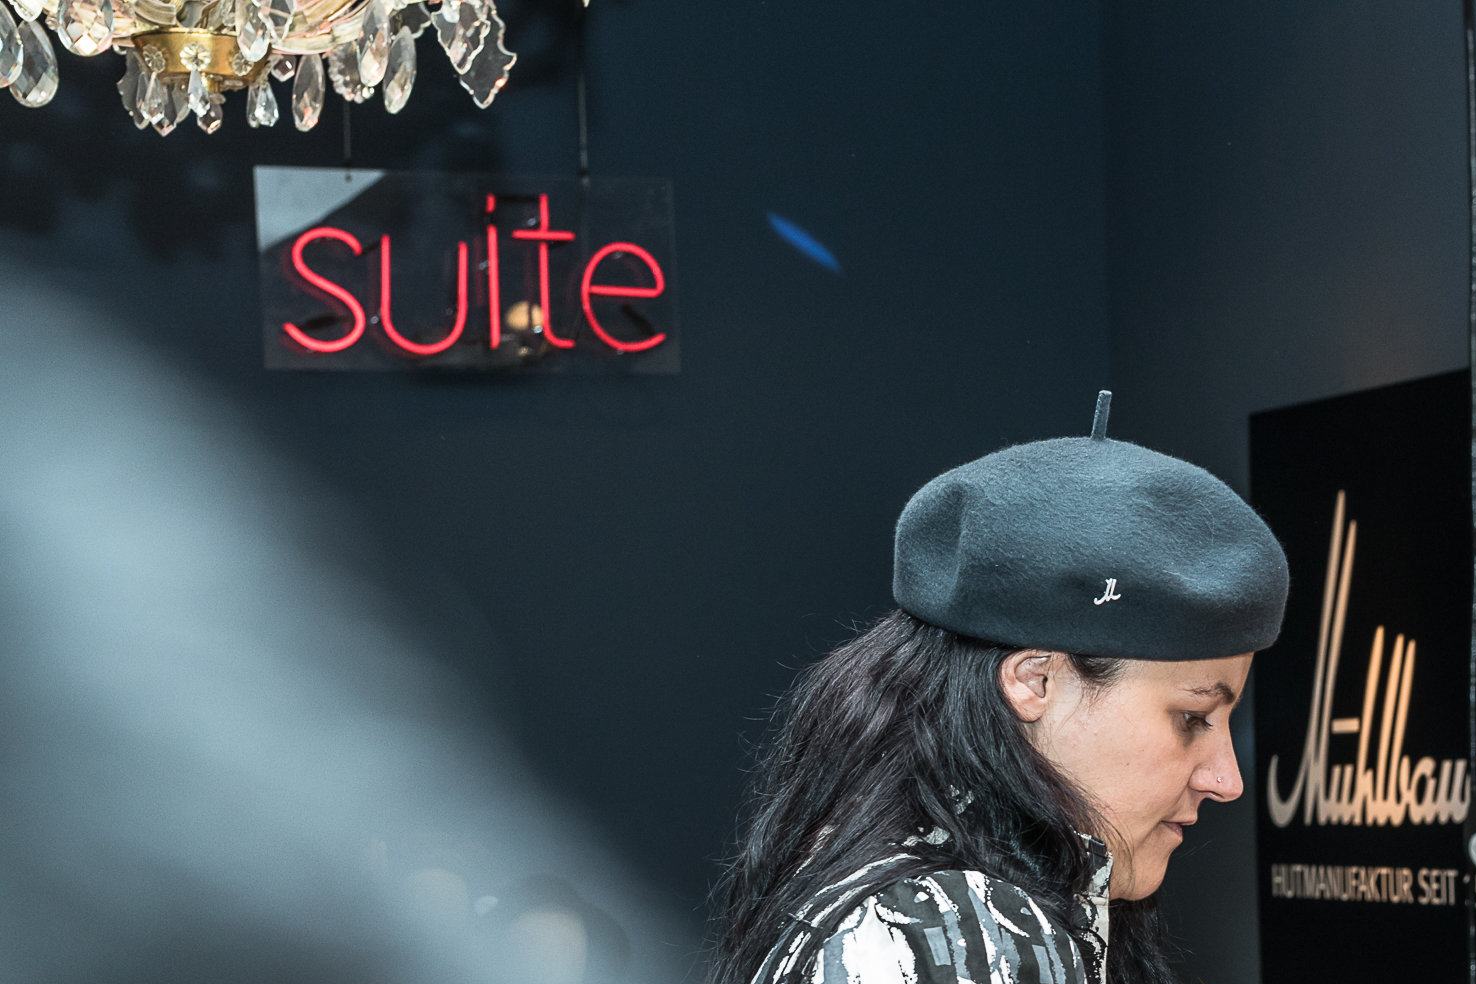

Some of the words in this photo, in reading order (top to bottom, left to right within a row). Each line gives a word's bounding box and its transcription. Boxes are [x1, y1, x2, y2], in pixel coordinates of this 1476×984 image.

[282, 193, 666, 354] suite
[1271, 864, 1414, 905] HUTMANUFAKTUR
[1417, 867, 1459, 906] SEIT
